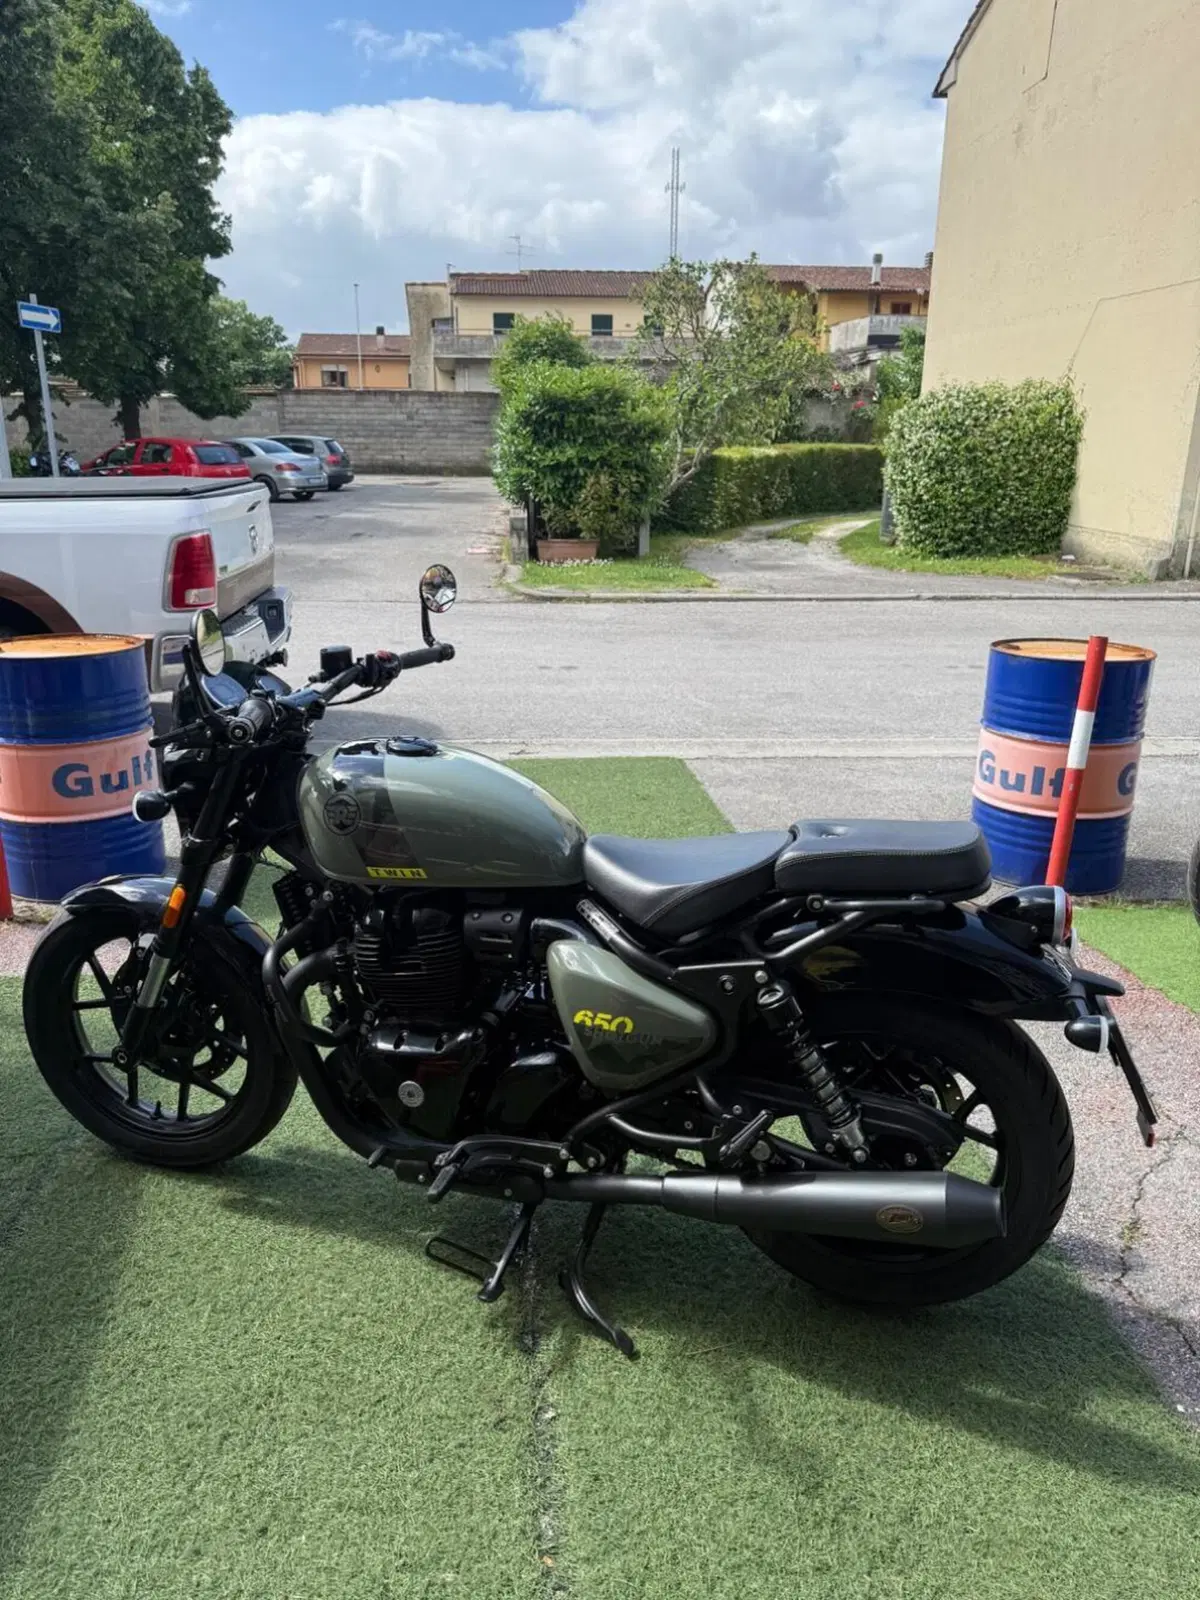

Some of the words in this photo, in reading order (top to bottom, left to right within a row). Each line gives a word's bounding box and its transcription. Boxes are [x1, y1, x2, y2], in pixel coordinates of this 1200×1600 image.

[52, 750, 153, 798] Gulf
[371, 867, 422, 877] TWIN
[573, 1010, 634, 1034] 650
